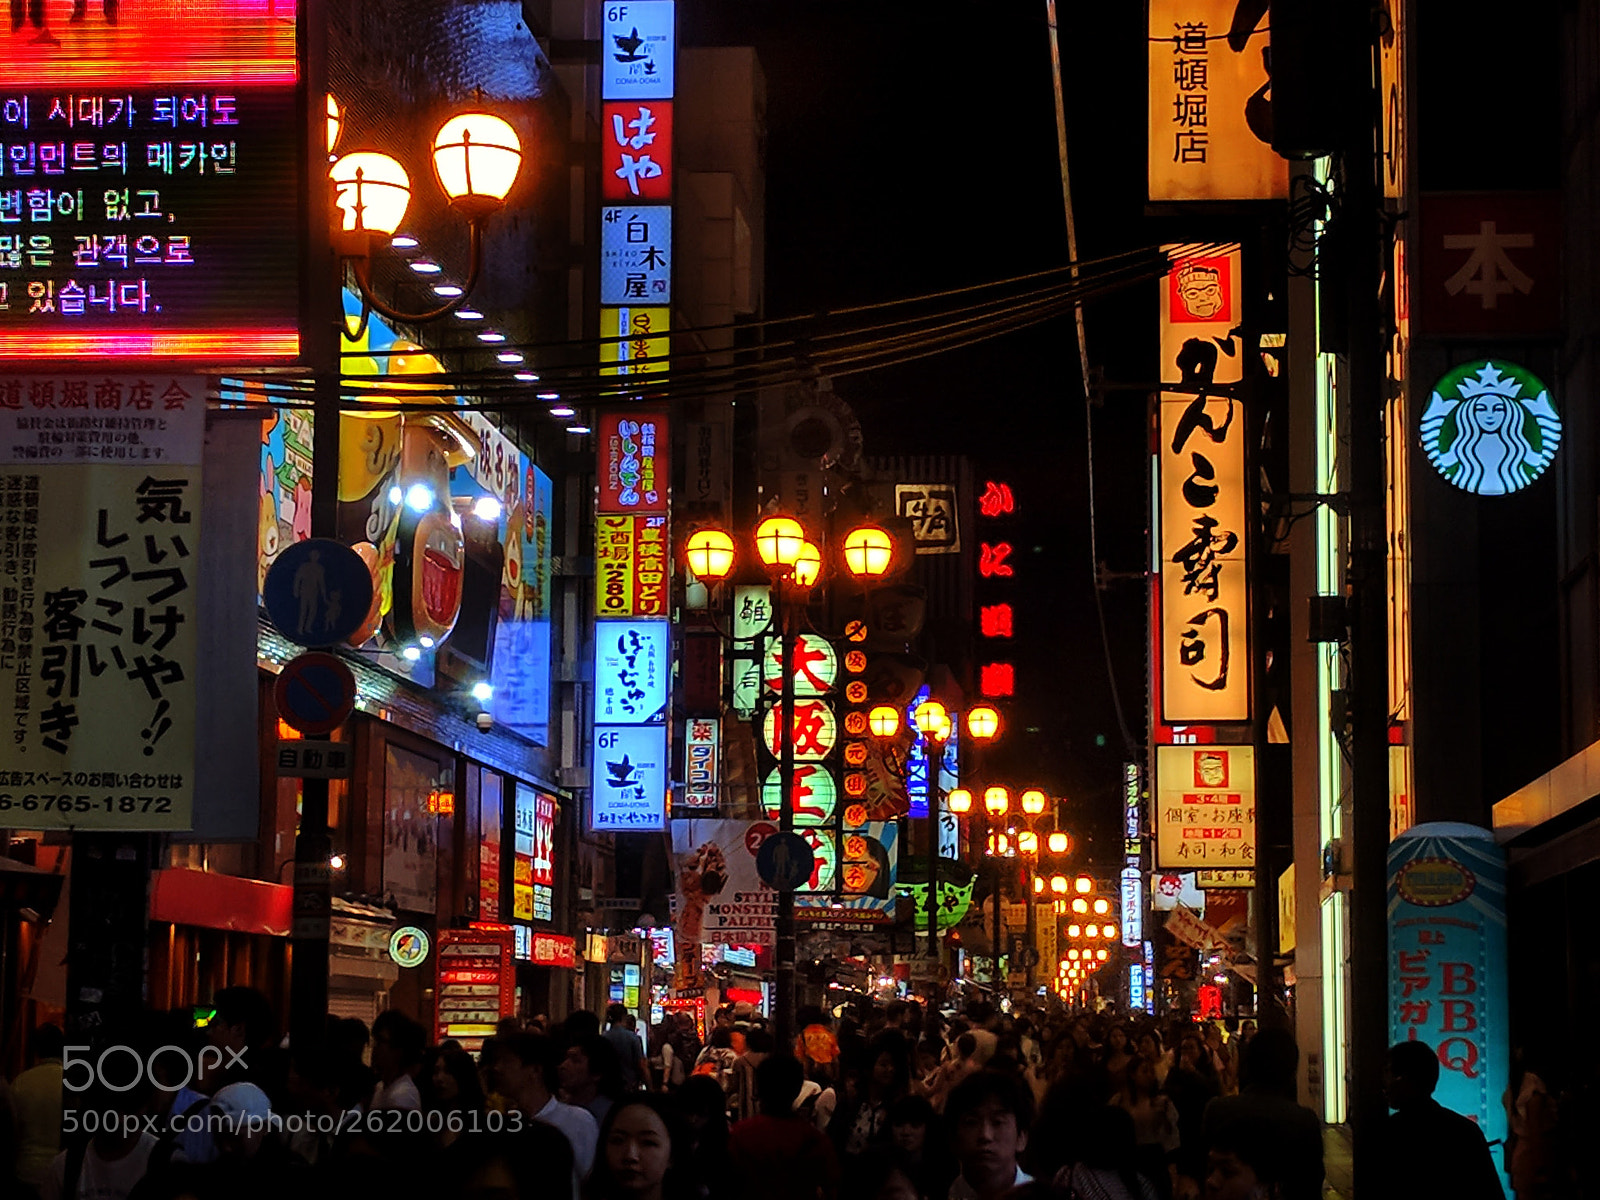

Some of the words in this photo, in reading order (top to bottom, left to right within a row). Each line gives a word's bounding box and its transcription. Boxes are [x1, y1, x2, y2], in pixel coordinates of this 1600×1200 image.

[607, 7, 628, 22] 6F
[1173, 21, 1209, 165] 道頓堀店
[3, 95, 29, 129] 이
[49, 95, 138, 128] 시대가
[152, 95, 240, 128] 되어도
[0, 140, 128, 176] 인먼트의
[146, 140, 238, 175] 메카인
[612, 106, 664, 196] はや
[103, 187, 177, 223] 없고,
[604, 210, 622, 224] 4F
[72, 234, 195, 269] 관객으로
[623, 214, 667, 299] 白木屋
[1443, 221, 1535, 310] 本
[27, 278, 163, 315] 있습니다.
[0, 379, 193, 411] 道頓堀商店会
[86, 509, 131, 677] しつこい
[39, 587, 89, 755] 客引き
[598, 732, 619, 748] 6F
[277, 748, 347, 770] 自動車
[0, 771, 183, 789] 広告スペースのお問い合わせは
[1436, 961, 1480, 1079] BBQ
